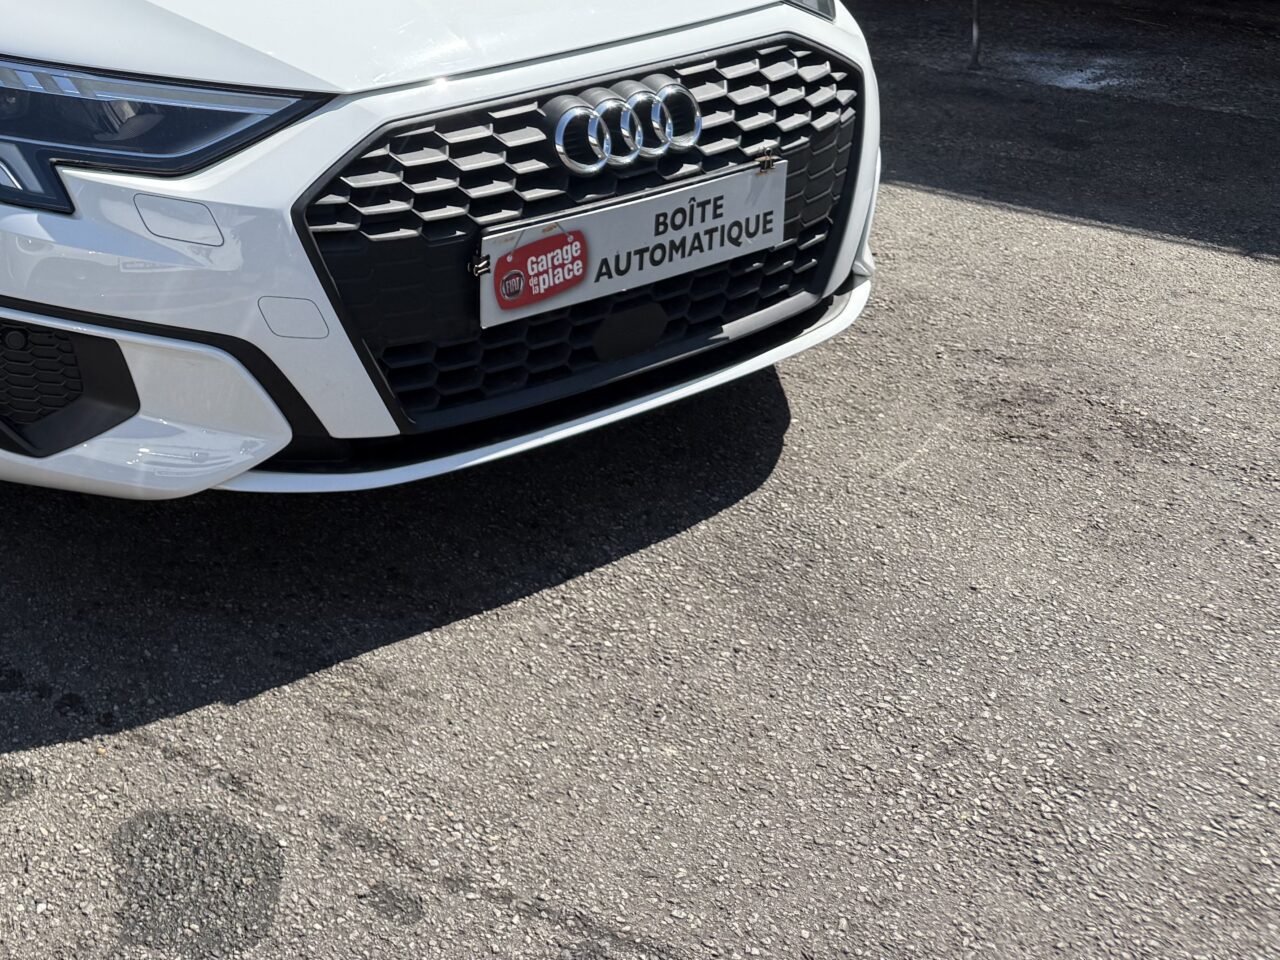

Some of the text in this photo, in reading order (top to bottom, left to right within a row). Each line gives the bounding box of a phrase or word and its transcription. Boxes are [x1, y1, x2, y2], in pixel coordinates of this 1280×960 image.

[654, 195, 725, 237] BOÎTE
[527, 241, 581, 276] Garage
[594, 210, 774, 283] AUTOMATIQUE
[505, 276, 520, 294] FIAT
[528, 276, 538, 288] de
[532, 285, 539, 295] la
[540, 259, 583, 293] place
